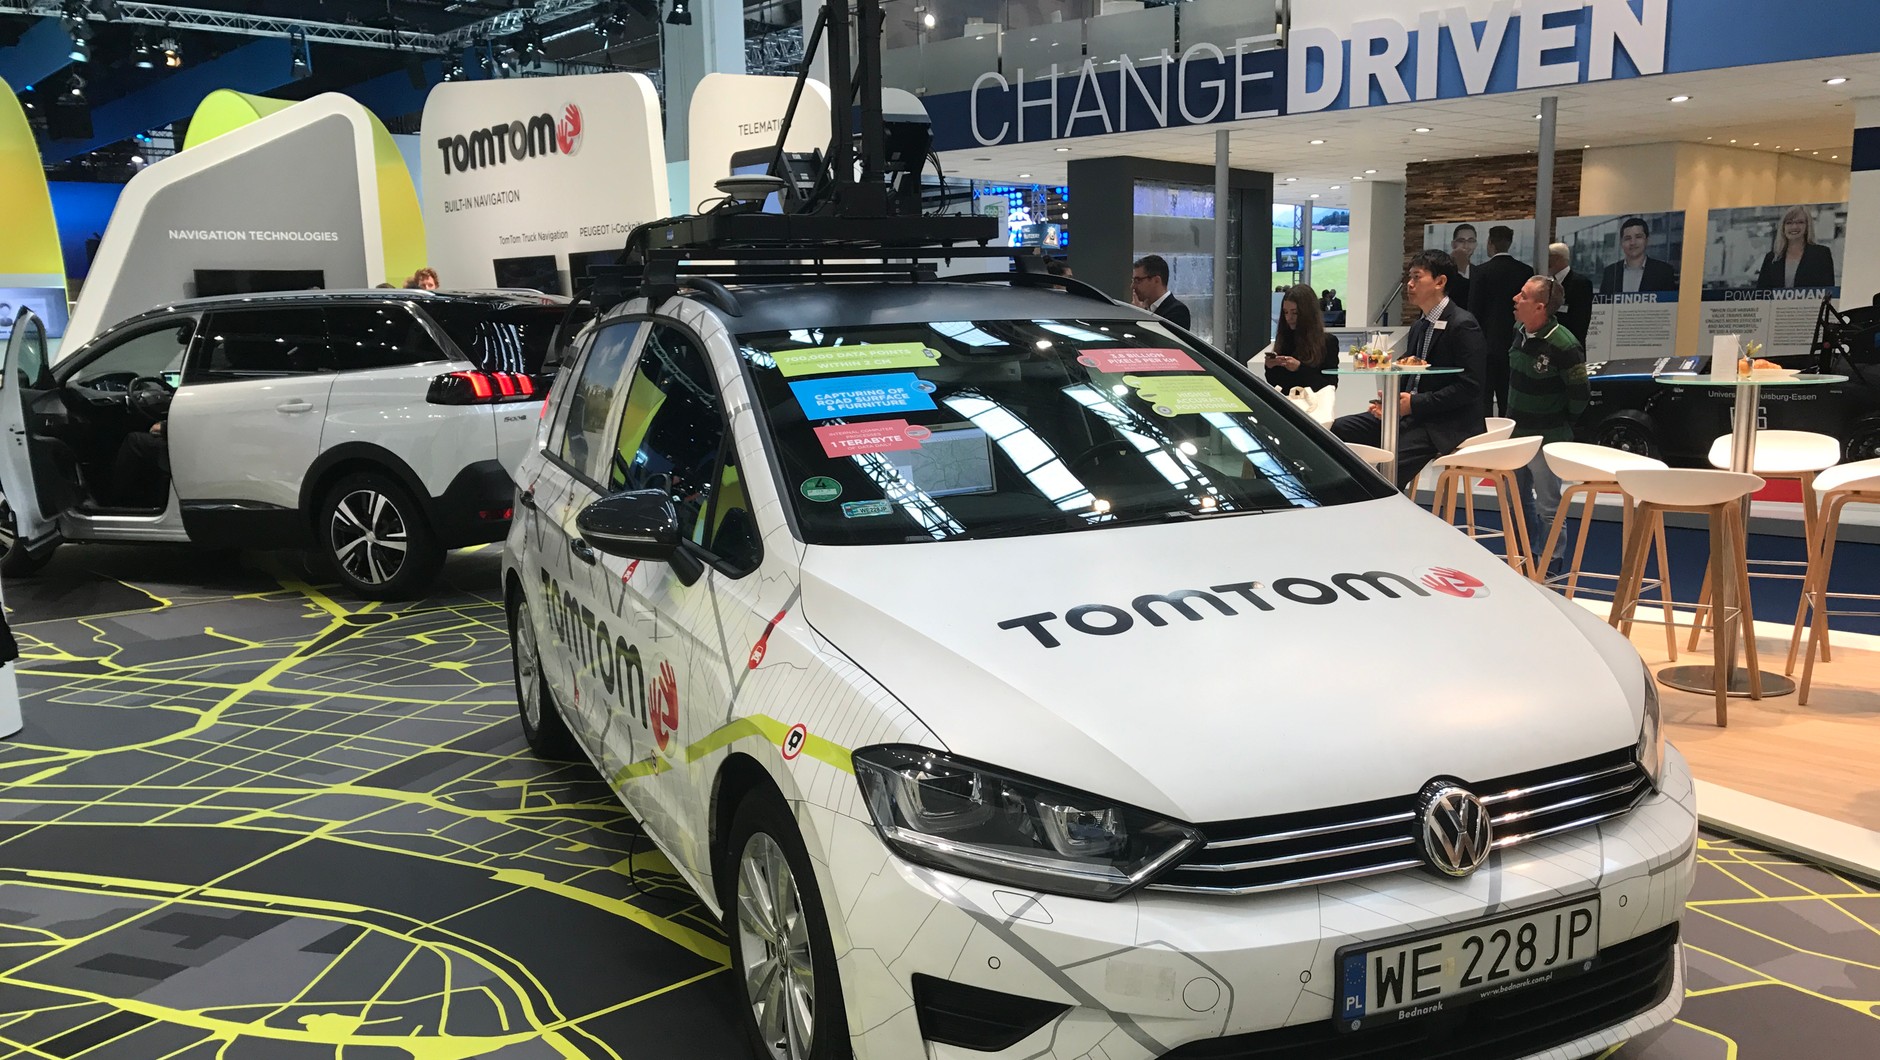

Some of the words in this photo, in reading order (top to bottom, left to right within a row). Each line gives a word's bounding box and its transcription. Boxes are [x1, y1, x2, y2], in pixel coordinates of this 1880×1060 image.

[438, 113, 557, 175] TOMTOM
[444, 196, 473, 213] BUILT-IN
[474, 189, 520, 208] NAVIGATION
[168, 229, 246, 240] NAVIGATION
[249, 230, 338, 241] TECHNOLOGIES
[580, 224, 609, 237] PEUGEOT
[499, 234, 521, 245] TomTom
[522, 233, 537, 243] Truck
[538, 230, 568, 242] Navigation
[1591, 293, 1657, 304] ATHFINDER
[784, 353, 833, 363] 700,000
[817, 361, 860, 369] WITHIN
[814, 389, 885, 400] CAPTURING
[816, 397, 852, 406] ROAD
[855, 393, 910, 403] SURFACE
[1760, 393, 1817, 401] uisburg-Essen
[838, 400, 907, 410] FURNITURE
[838, 435, 903, 447] TERABYTE
[997, 570, 1432, 649] TOMTOM
[541, 566, 648, 730] TOMTOM
[1375, 942, 1442, 1009] WE
[1398, 1001, 1443, 1020] Bednarek
[1480, 971, 1553, 999] www.bednarek.com.pl
[1346, 997, 1362, 1011] PL
